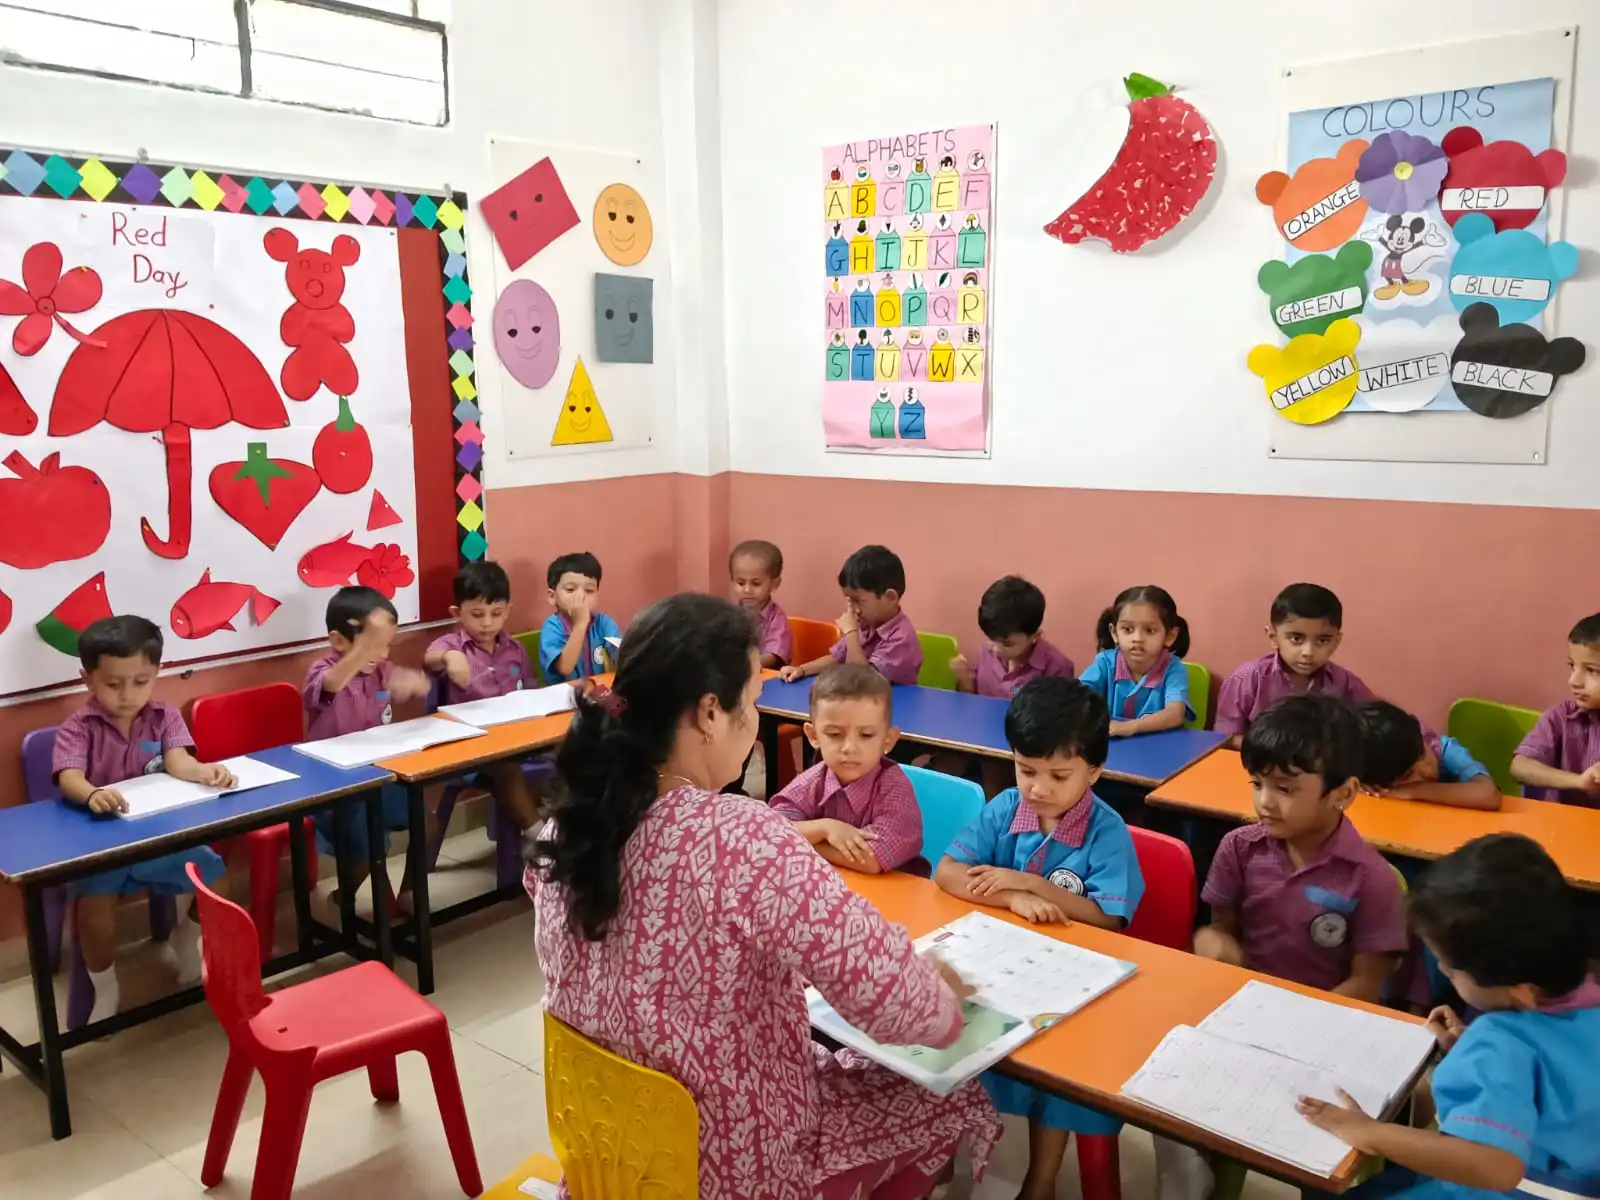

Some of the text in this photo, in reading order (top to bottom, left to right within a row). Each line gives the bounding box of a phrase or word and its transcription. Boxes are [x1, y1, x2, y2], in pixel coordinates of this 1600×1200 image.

[1322, 85, 1496, 138] COLOURS
[843, 129, 956, 164] ALPHABETS
[827, 179, 984, 217] A B C D E F
[1287, 183, 1359, 236] ORANGE
[1459, 187, 1509, 210] RED
[112, 211, 167, 247] Red
[830, 236, 980, 272] G H I J K L
[133, 254, 188, 299] Day
[1464, 276, 1525, 298] BLUE
[828, 292, 979, 329] M N O P Q R
[1279, 291, 1345, 324] GREEN
[831, 352, 978, 378] S T U V W X
[1276, 357, 1347, 408] YELLOW
[1365, 357, 1440, 392] WHITE
[1463, 362, 1538, 391] BLACK
[874, 409, 921, 438] Y Z
